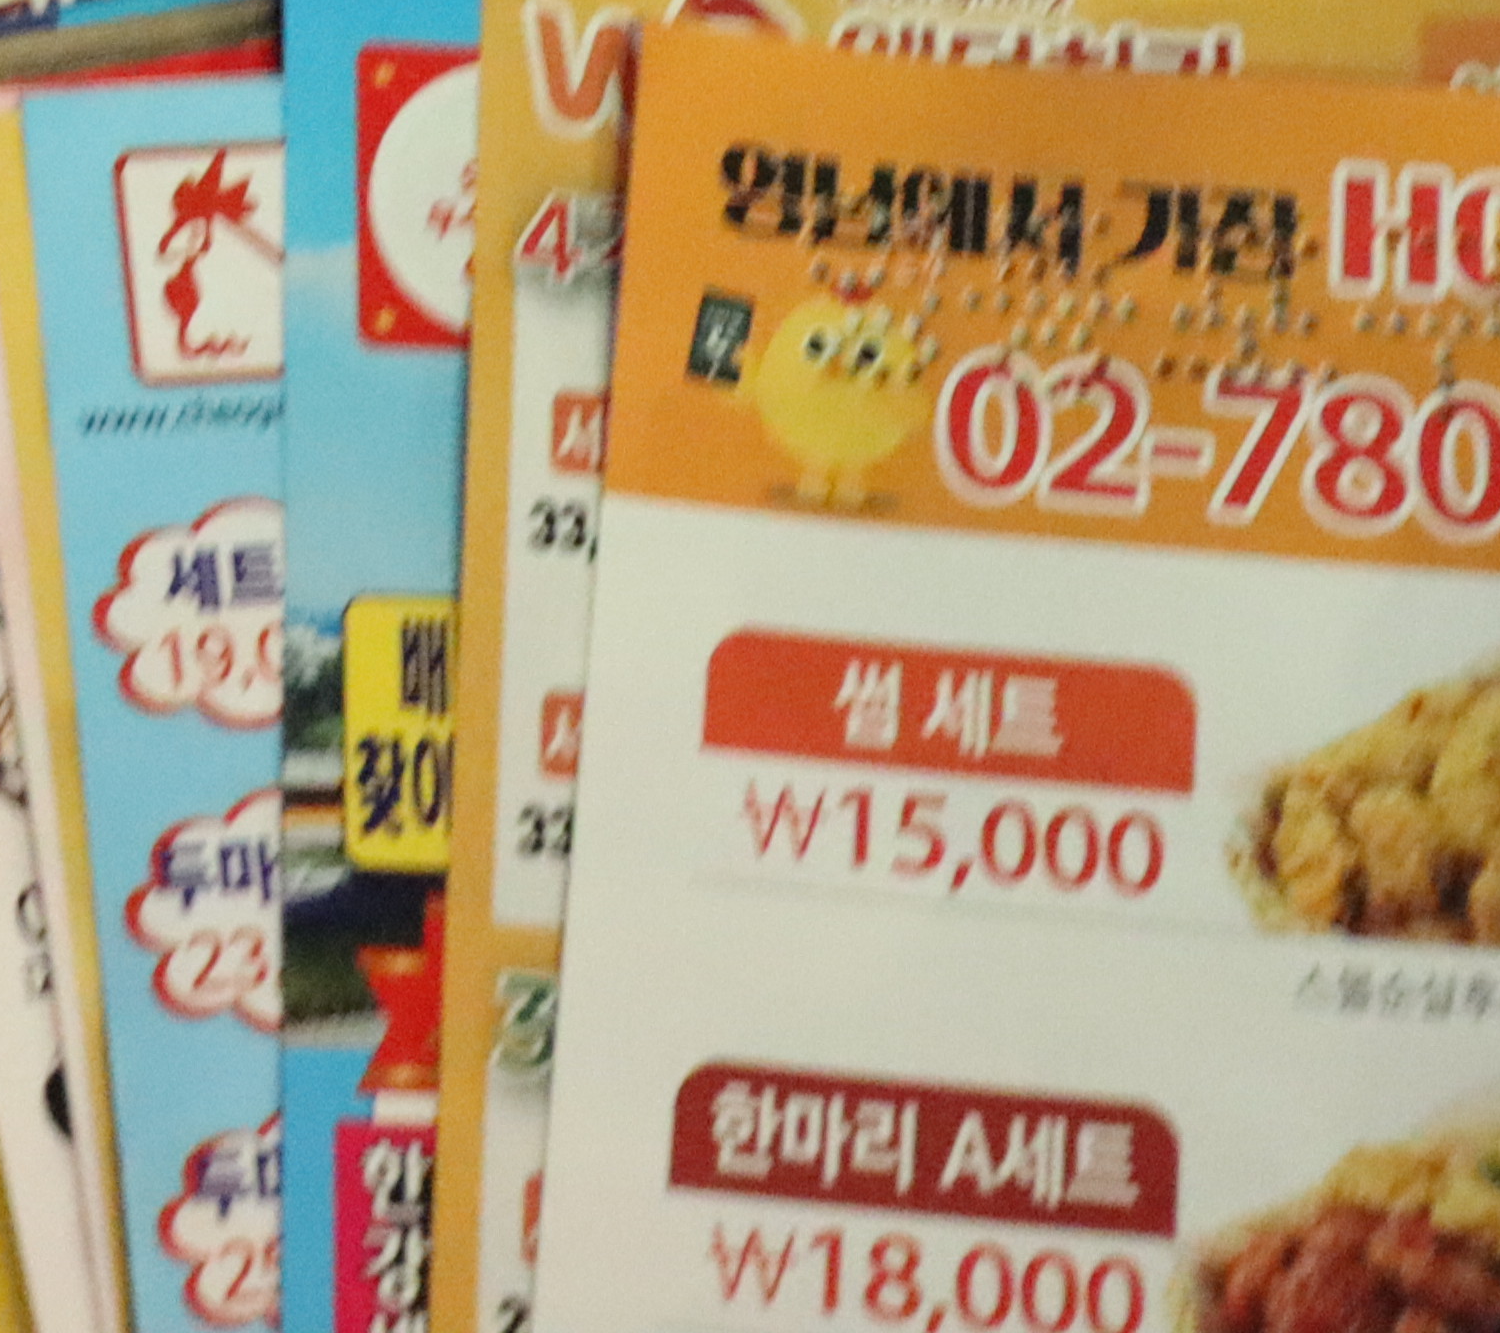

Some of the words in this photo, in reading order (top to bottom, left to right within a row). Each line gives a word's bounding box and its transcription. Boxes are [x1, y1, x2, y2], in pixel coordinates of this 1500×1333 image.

[922, 668, 1063, 759] 세트
[711, 1080, 919, 1195] 한마리
[940, 1110, 1139, 1211] A세트
